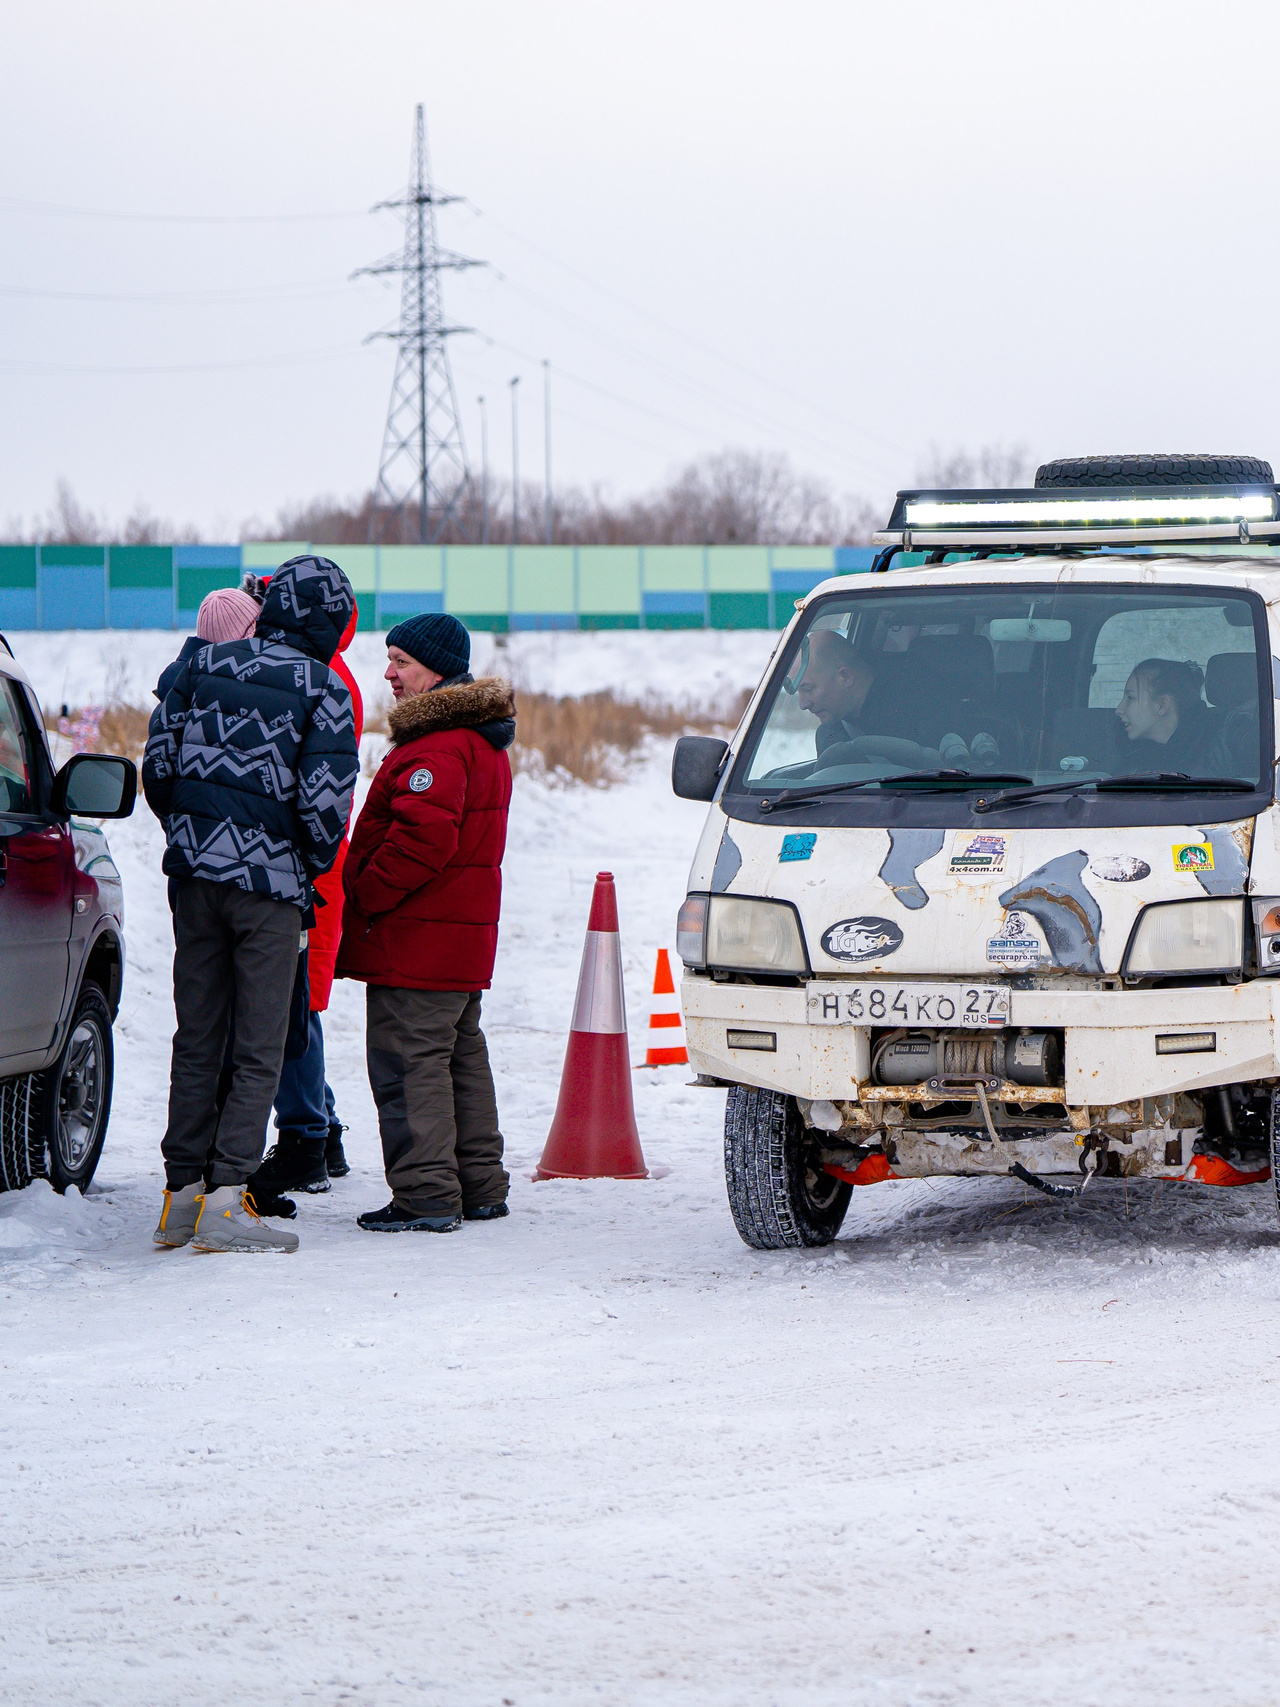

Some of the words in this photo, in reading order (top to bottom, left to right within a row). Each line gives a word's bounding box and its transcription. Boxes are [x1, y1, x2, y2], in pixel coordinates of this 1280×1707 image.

[279, 583, 291, 611] FILA
[321, 602, 344, 613] FILA
[236, 662, 261, 682] FILA
[293, 664, 305, 688] FILA
[269, 709, 294, 729] FILA
[258, 764, 274, 794] FILA
[307, 760, 331, 784] FILA
[307, 822, 323, 842] FILA
[990, 940, 1039, 948] samson
[988, 954, 1040, 962] securapro.ru
[966, 989, 1000, 1014] 27
[963, 1014, 987, 1024] RUS
